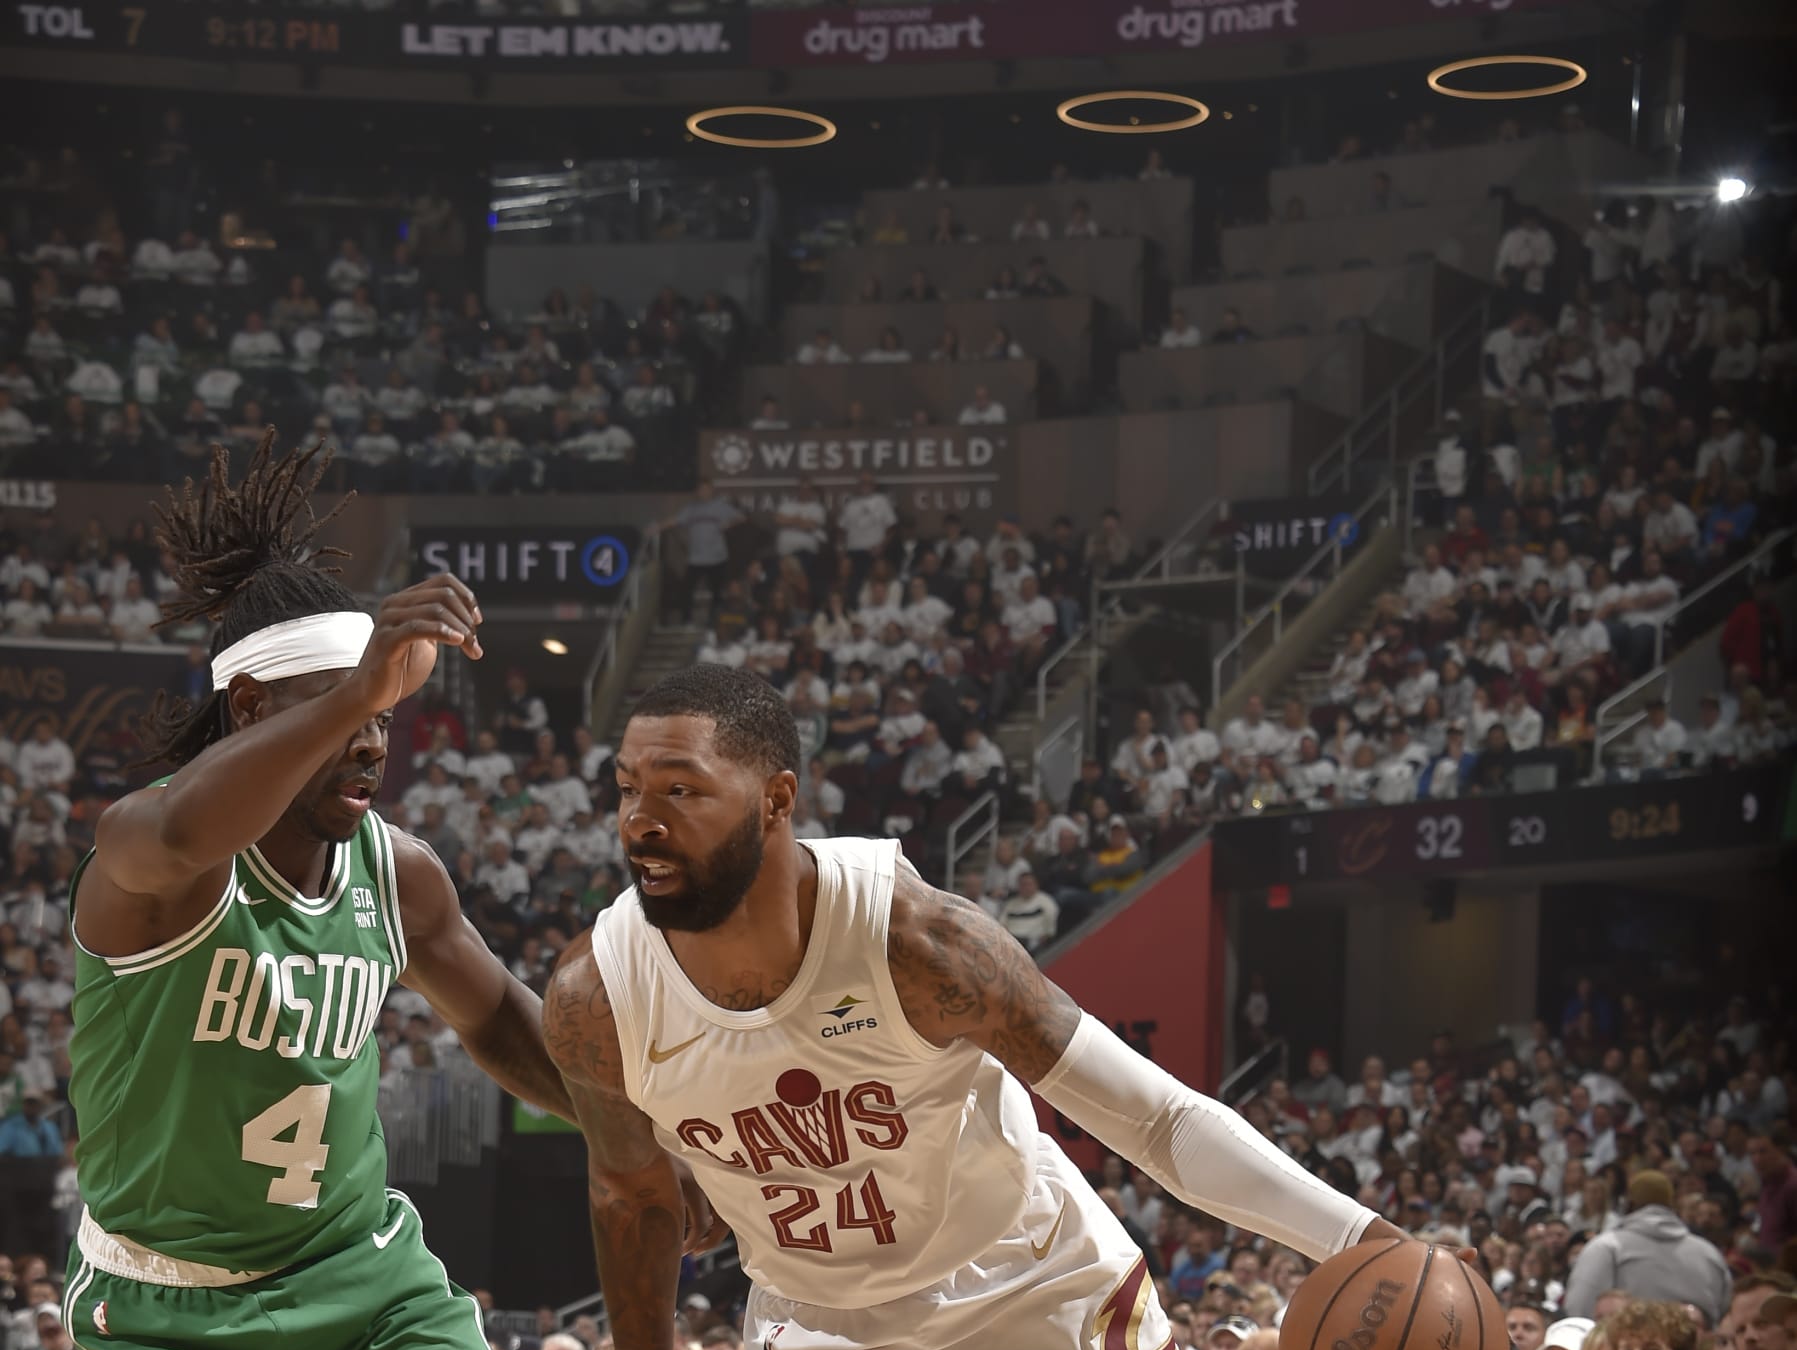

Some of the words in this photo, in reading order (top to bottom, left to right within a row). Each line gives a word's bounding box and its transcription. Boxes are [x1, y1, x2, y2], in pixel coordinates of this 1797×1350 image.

[18, 4, 95, 40] TOL
[120, 8, 146, 46] 7
[284, 19, 341, 52] PM
[401, 22, 495, 57] LET
[496, 24, 569, 57] EM
[571, 21, 732, 57] KNOW.
[803, 19, 890, 63] drug
[895, 14, 986, 51] mart
[1116, 5, 1205, 48] drug
[1209, 0, 1300, 35] mart
[758, 436, 995, 471] WESTFIELD
[913, 488, 994, 512] CLUB
[1413, 813, 1464, 860] 32
[1508, 815, 1547, 847] 20
[1607, 800, 1682, 841] 9:24
[193, 947, 392, 1060] BOSTON
[821, 1017, 878, 1039] CLIFFS
[242, 1083, 332, 1210] 4
[676, 1078, 910, 1175] CAVS
[760, 1168, 897, 1253] 24
